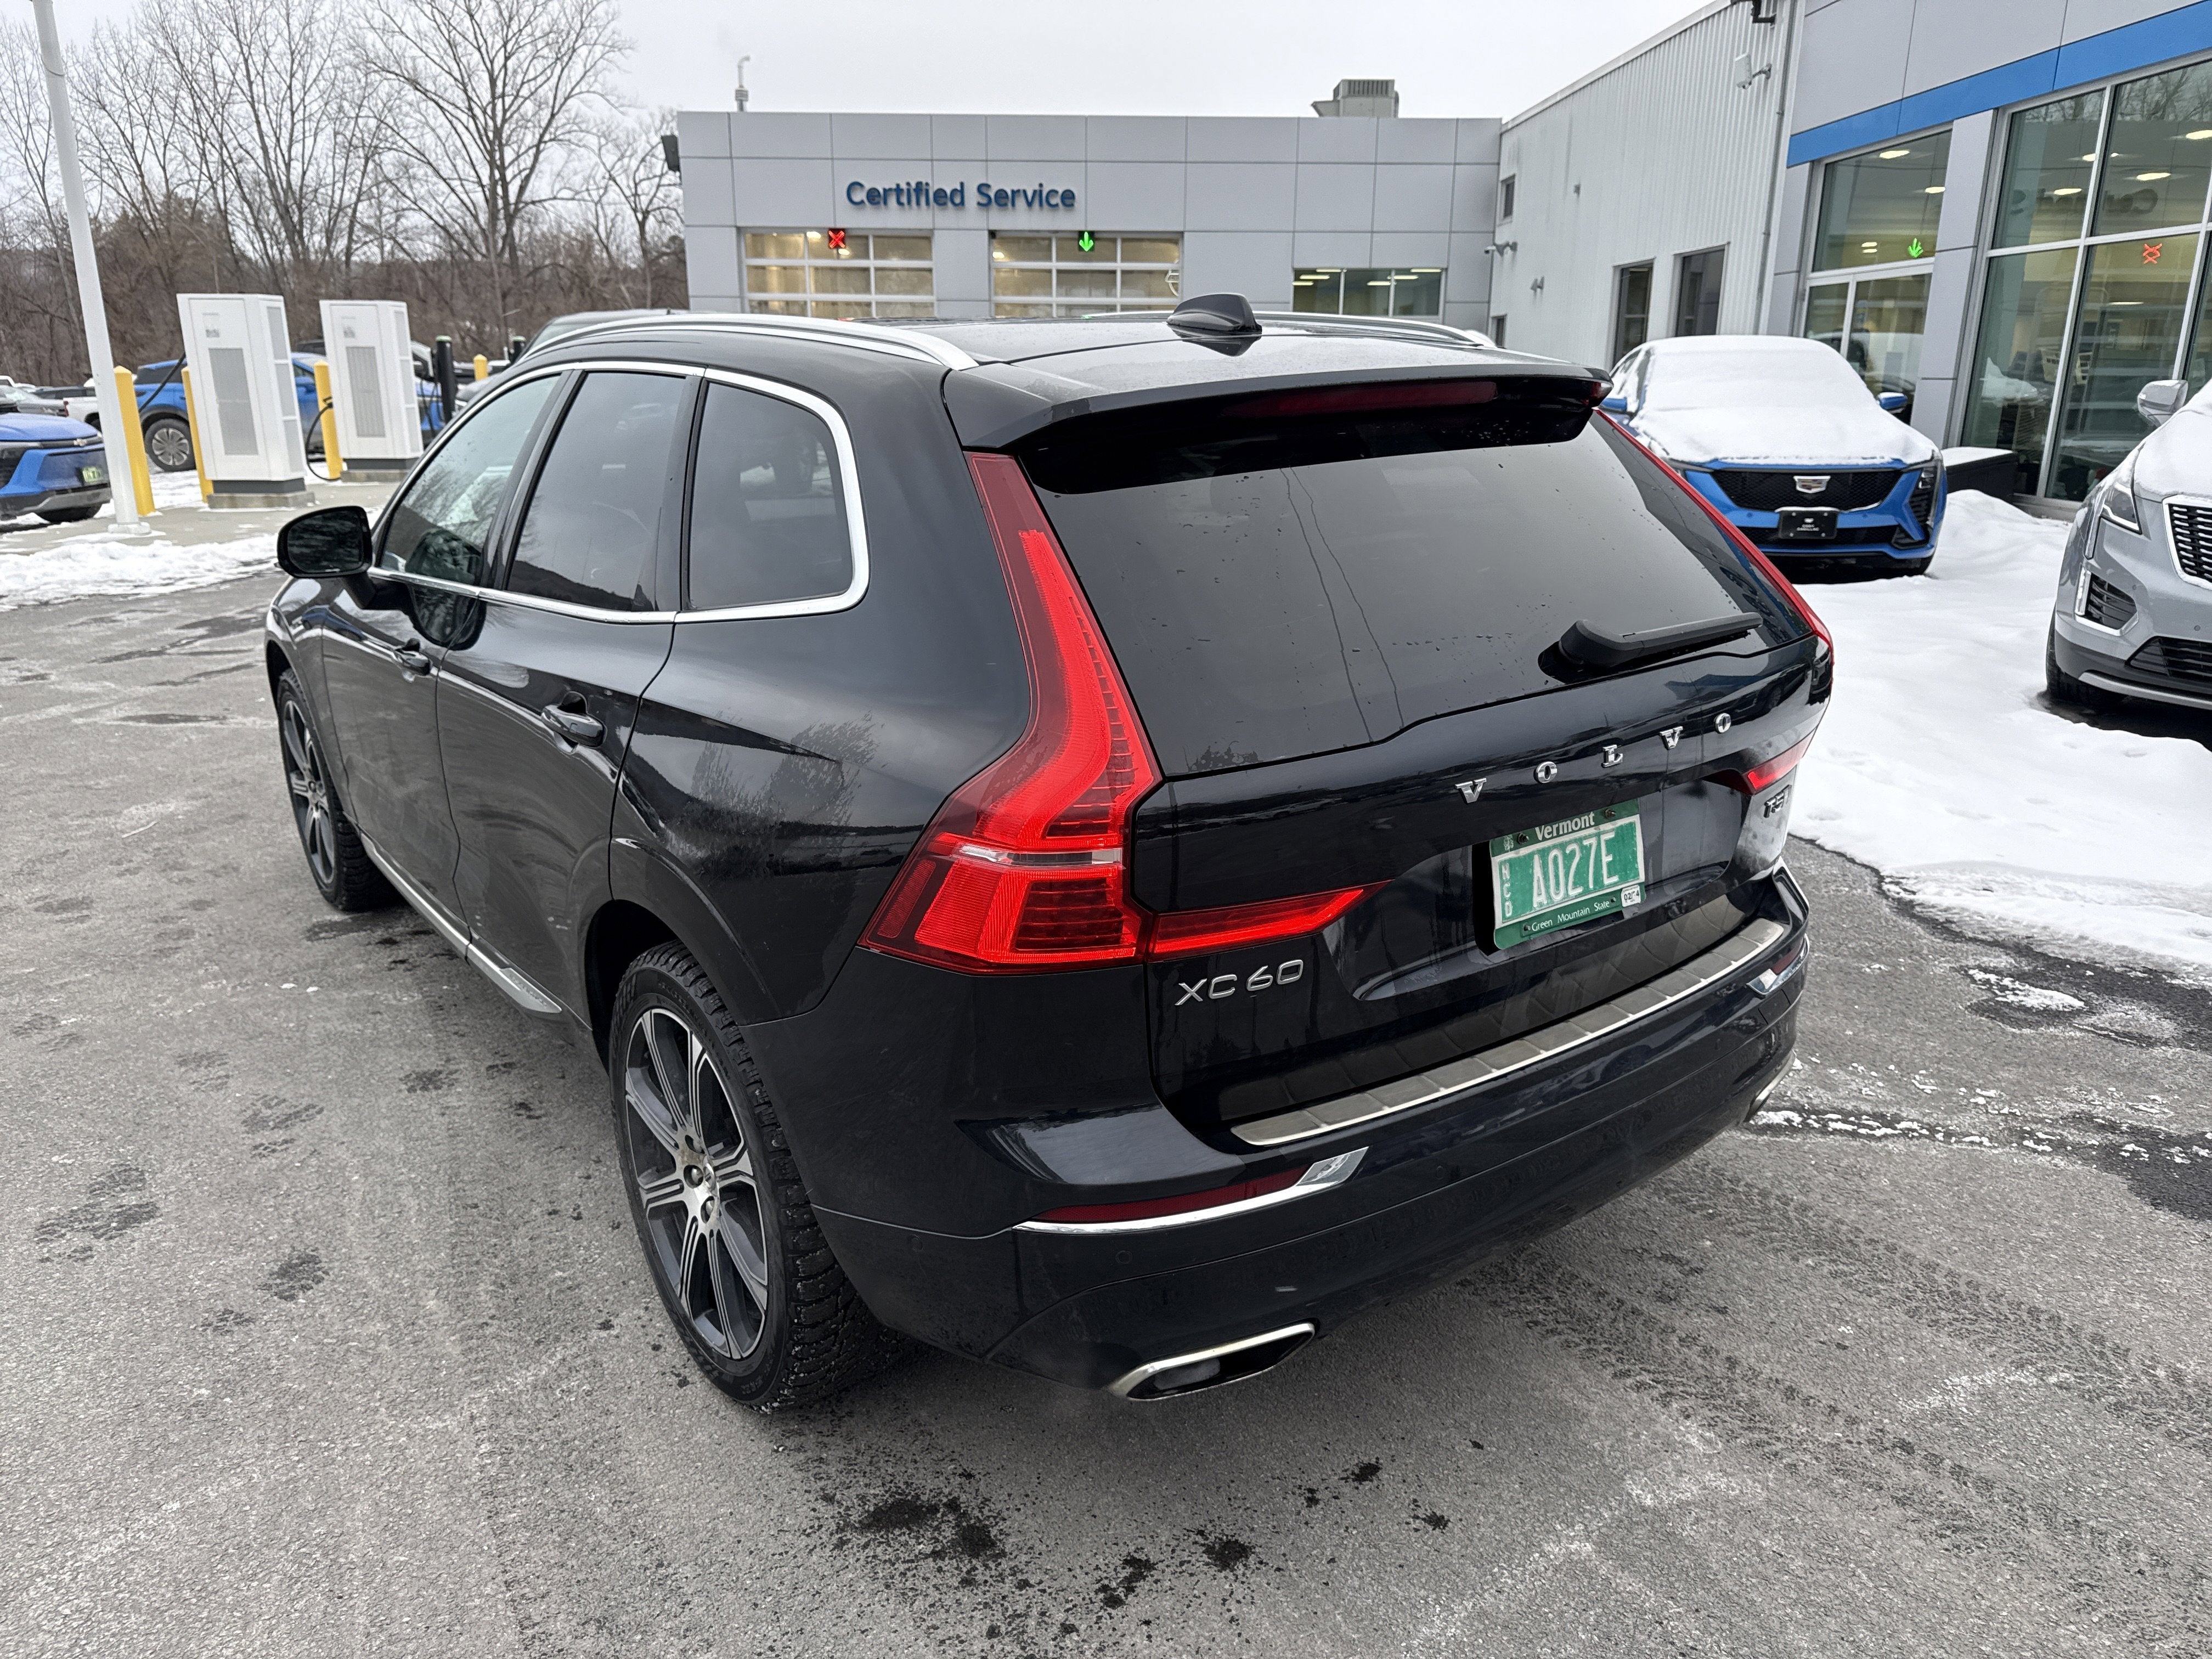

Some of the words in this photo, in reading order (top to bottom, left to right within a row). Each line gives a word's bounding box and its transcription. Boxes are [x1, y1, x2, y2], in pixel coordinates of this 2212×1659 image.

[847, 181, 966, 207] Certified
[977, 183, 1075, 207] Service
[1454, 713, 1731, 804] VOLVO
[1535, 811, 1595, 841] Vermont
[1533, 831, 1618, 909] A027E
[1532, 919, 1553, 932] Green
[1558, 907, 1590, 924] Mountain
[1594, 900, 1610, 912] State
